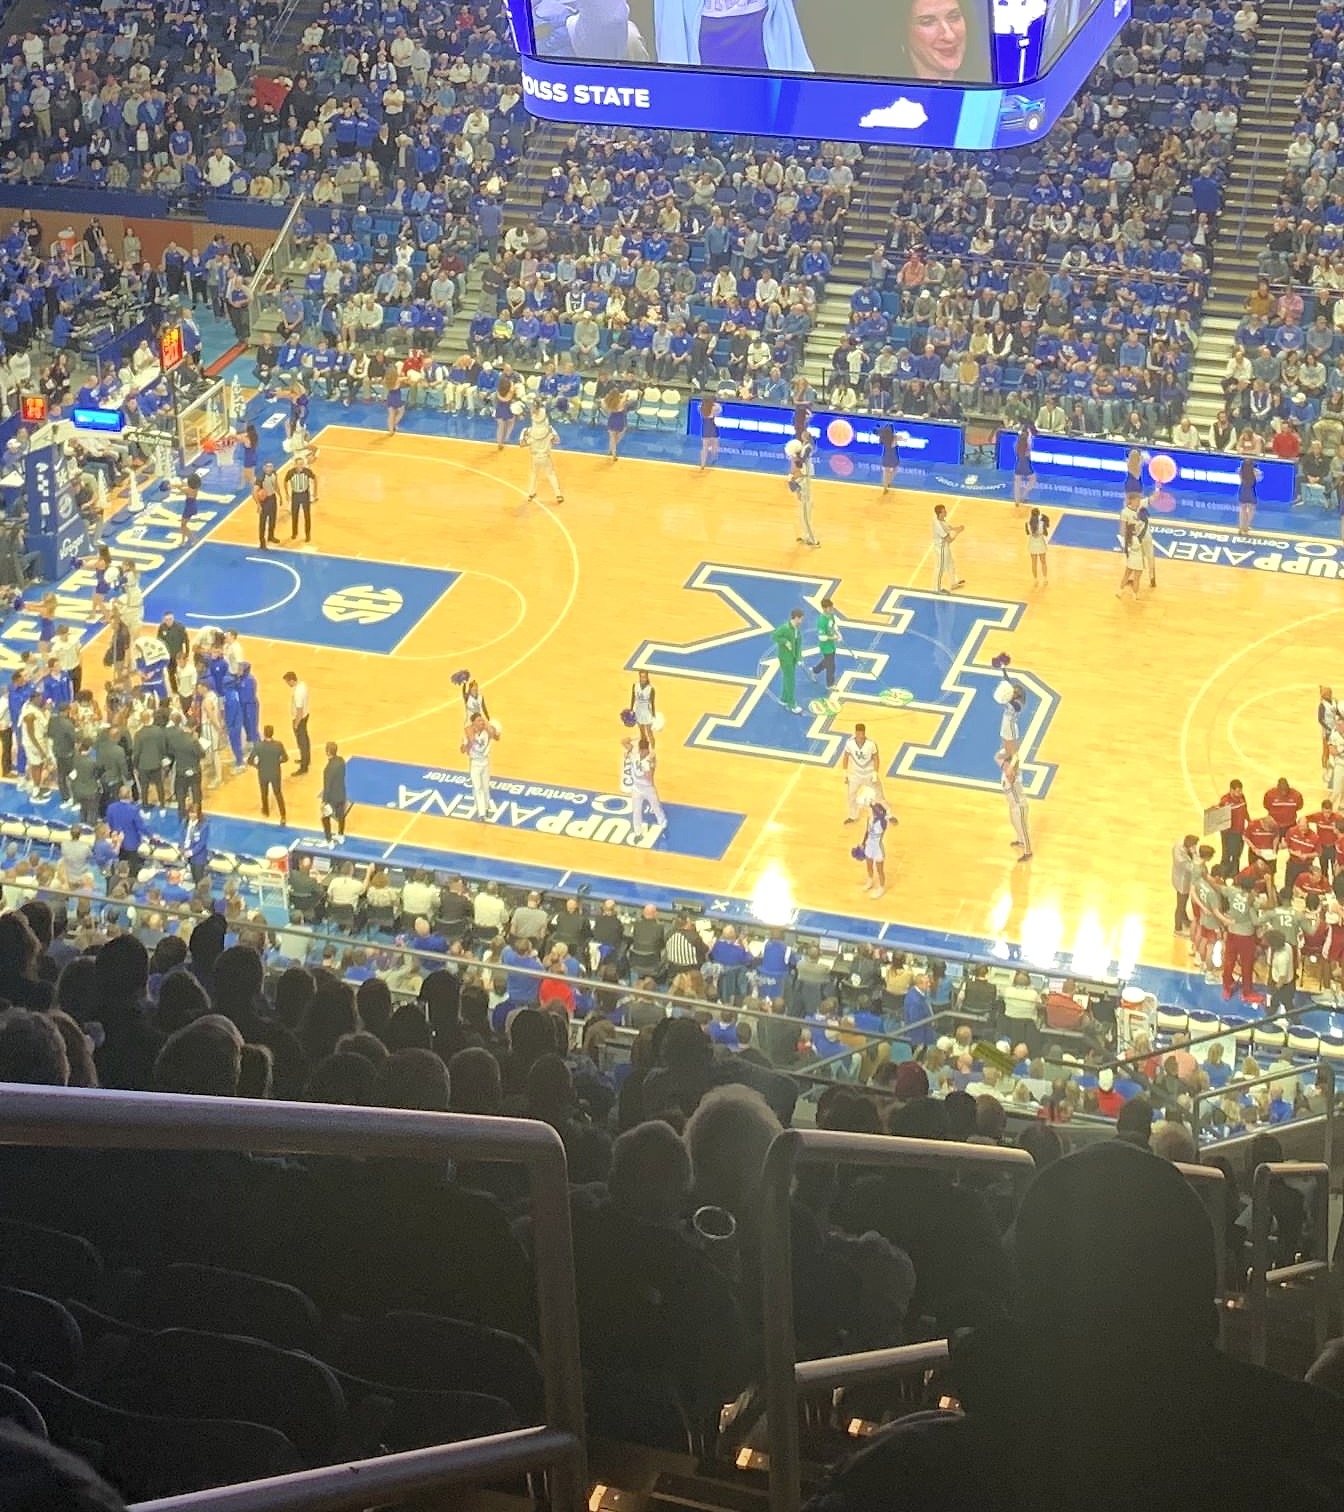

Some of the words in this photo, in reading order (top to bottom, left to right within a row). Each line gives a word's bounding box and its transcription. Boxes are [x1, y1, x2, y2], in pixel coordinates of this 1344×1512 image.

[574, 84, 651, 108] STATE
[1192, 530, 1229, 543] Bank
[1232, 536, 1290, 549] Central
[540, 786, 588, 804] Central
[1279, 915, 1293, 927] 12
